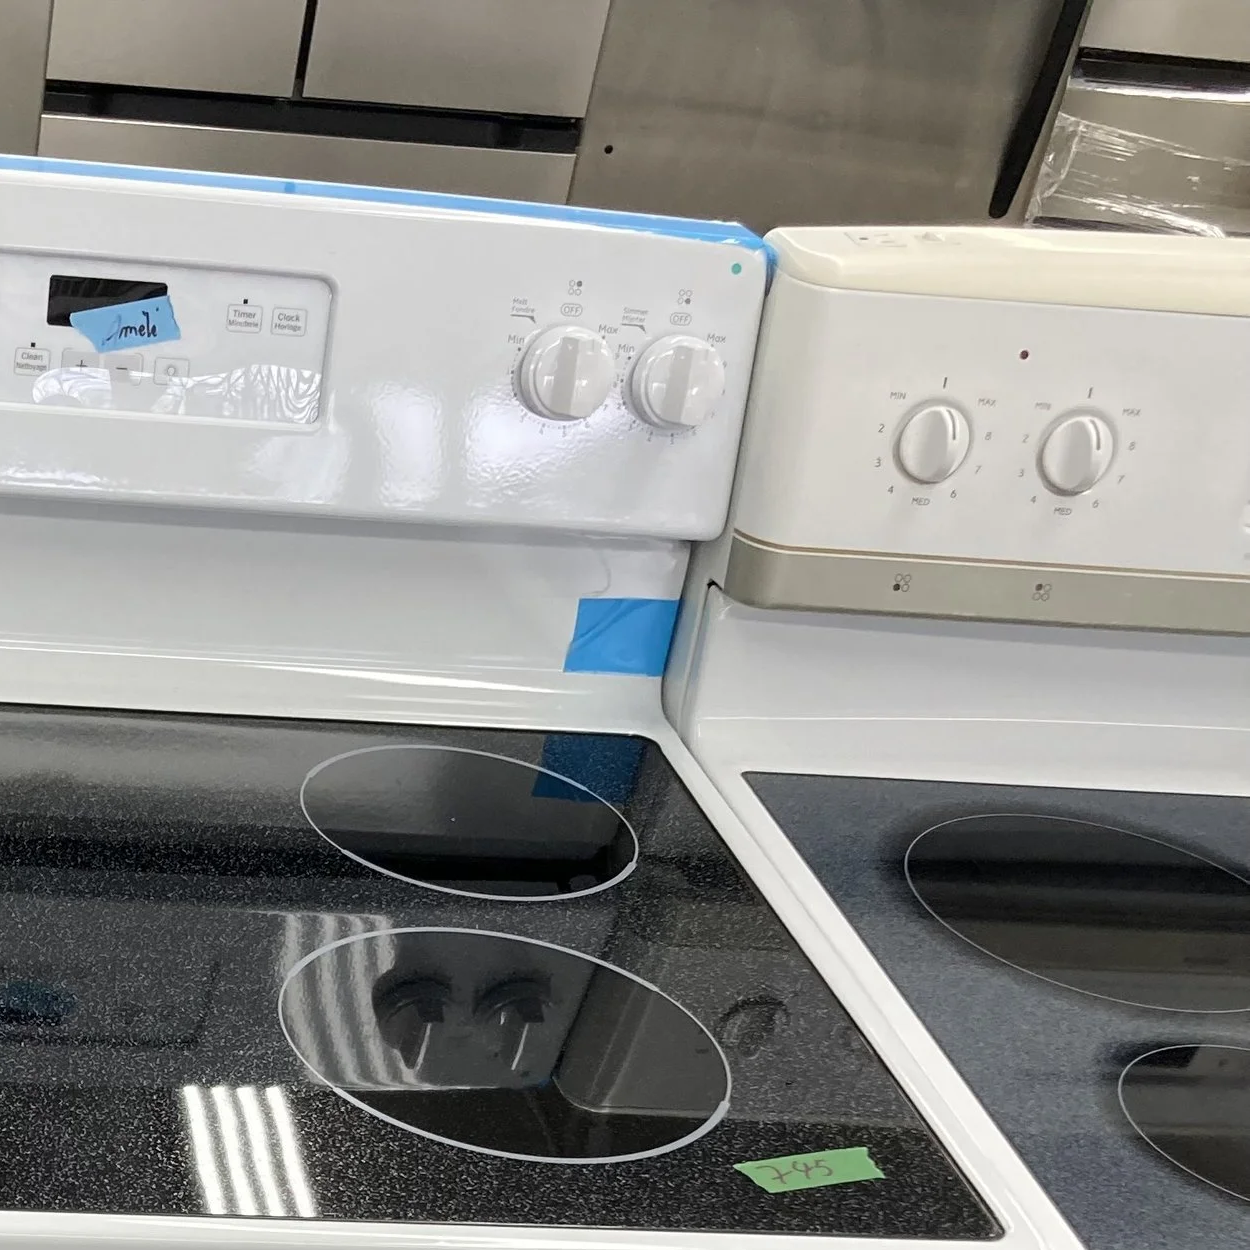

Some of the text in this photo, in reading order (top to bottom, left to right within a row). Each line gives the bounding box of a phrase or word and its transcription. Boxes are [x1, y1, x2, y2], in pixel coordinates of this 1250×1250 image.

[233, 309, 256, 319] Timer
[277, 312, 300, 322] Clock
[598, 324, 619, 334] Max
[508, 335, 525, 345] Min
[706, 333, 726, 343] Max
[618, 344, 635, 353] Min
[21, 352, 43, 362] Clean
[890, 391, 907, 400] MIN
[978, 398, 996, 407] MAX
[1122, 408, 1142, 417] MAX
[878, 423, 885, 433] 2
[985, 432, 992, 441] 8
[1022, 434, 1030, 444] 2
[1129, 441, 1136, 451] 8
[874, 457, 882, 468] 3
[975, 465, 982, 475] 7
[1018, 468, 1024, 478] 3
[1117, 475, 1125, 484] 7
[887, 485, 894, 494] 4
[950, 489, 957, 499] 6
[911, 497, 931, 506] MED
[1030, 495, 1037, 504] 4
[1092, 499, 1099, 509] 6
[1053, 507, 1072, 516] MED
